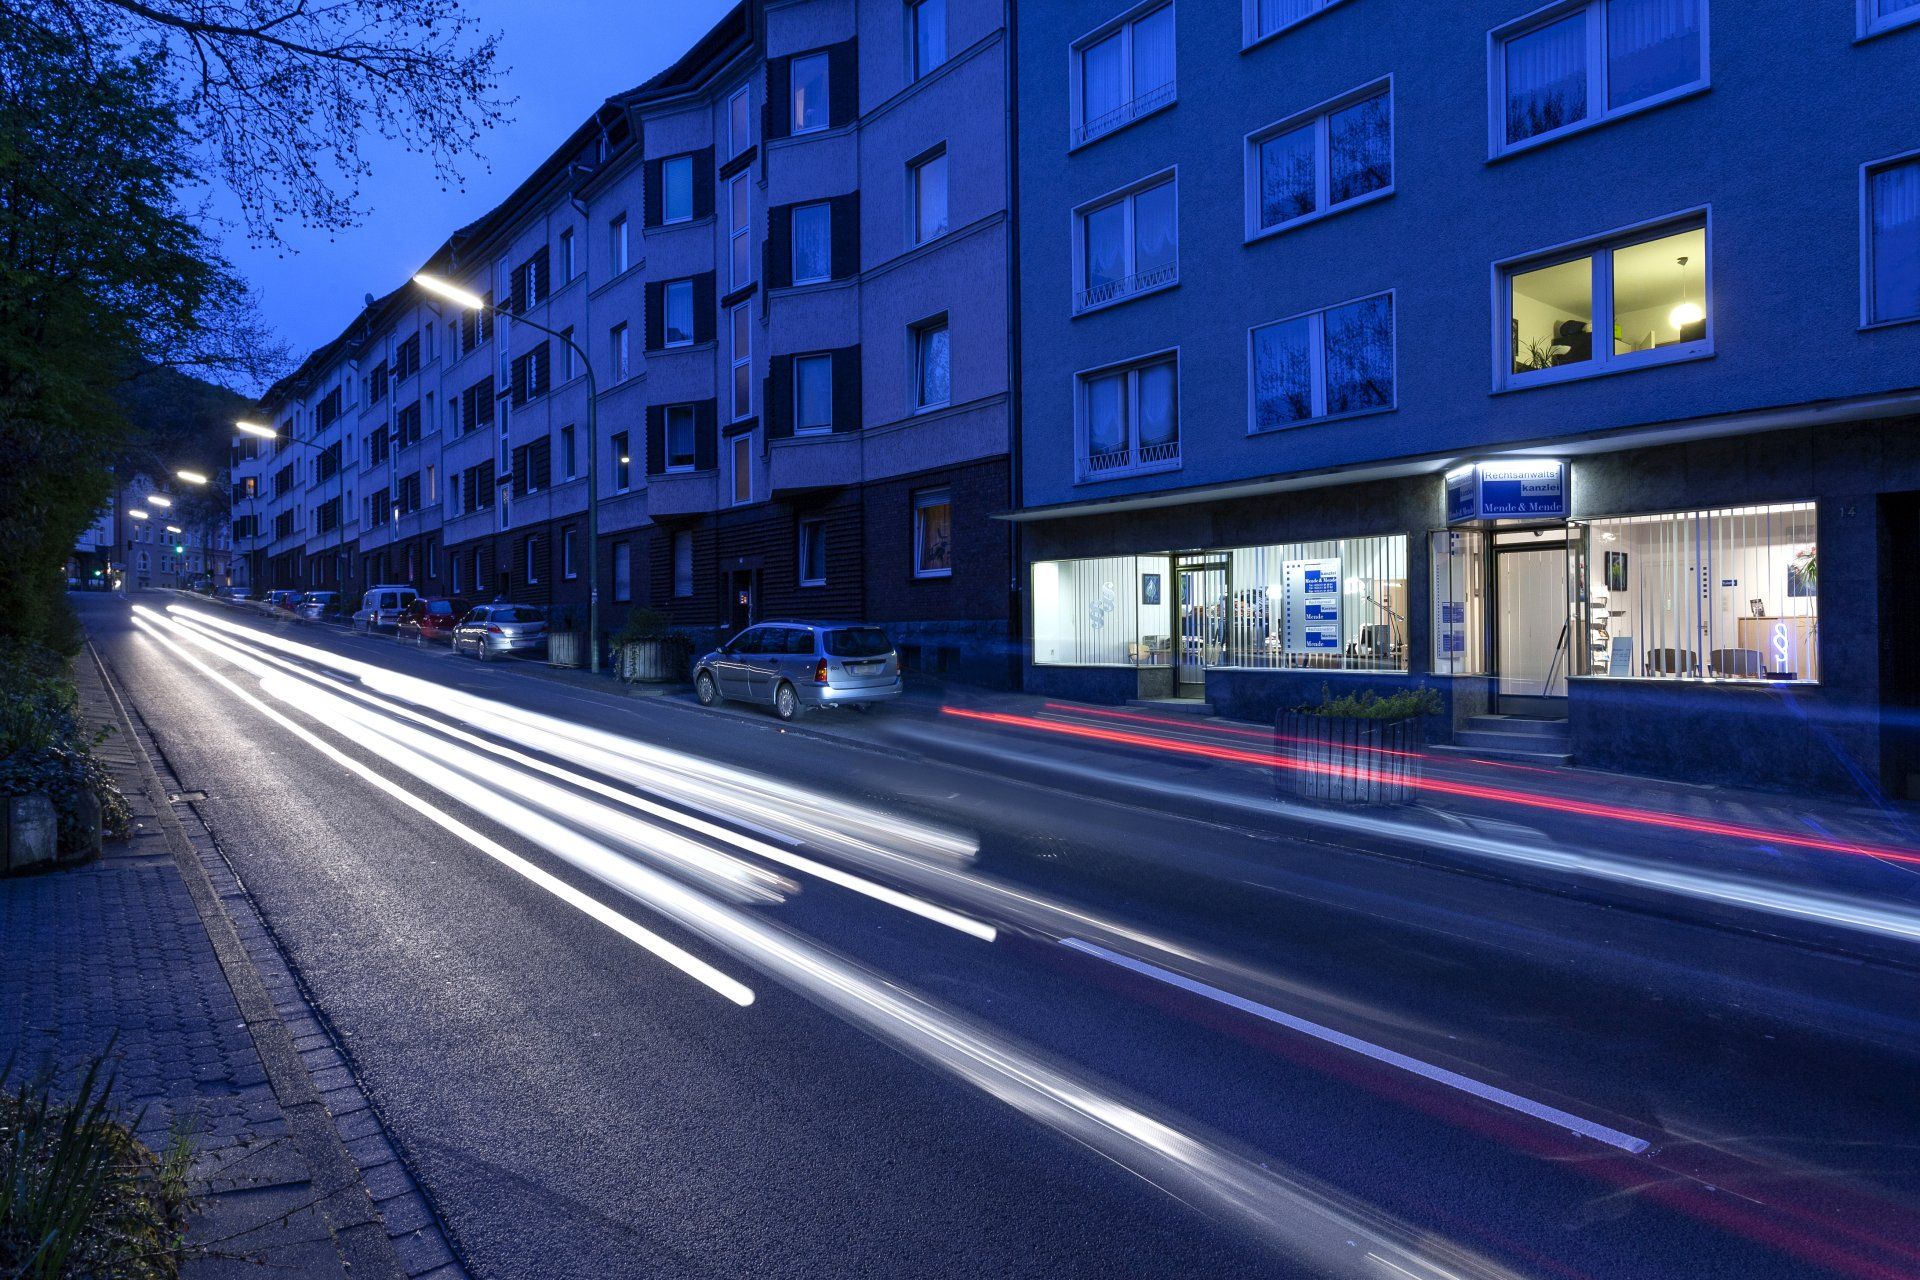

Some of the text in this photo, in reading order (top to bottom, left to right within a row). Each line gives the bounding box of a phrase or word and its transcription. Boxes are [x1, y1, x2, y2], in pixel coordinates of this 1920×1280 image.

[1485, 470, 1558, 480] Rechtsanwalts-
[1522, 482, 1560, 492] kanzlei
[1484, 502, 1562, 513] Mende & Mende
[1840, 506, 1857, 517] 14
